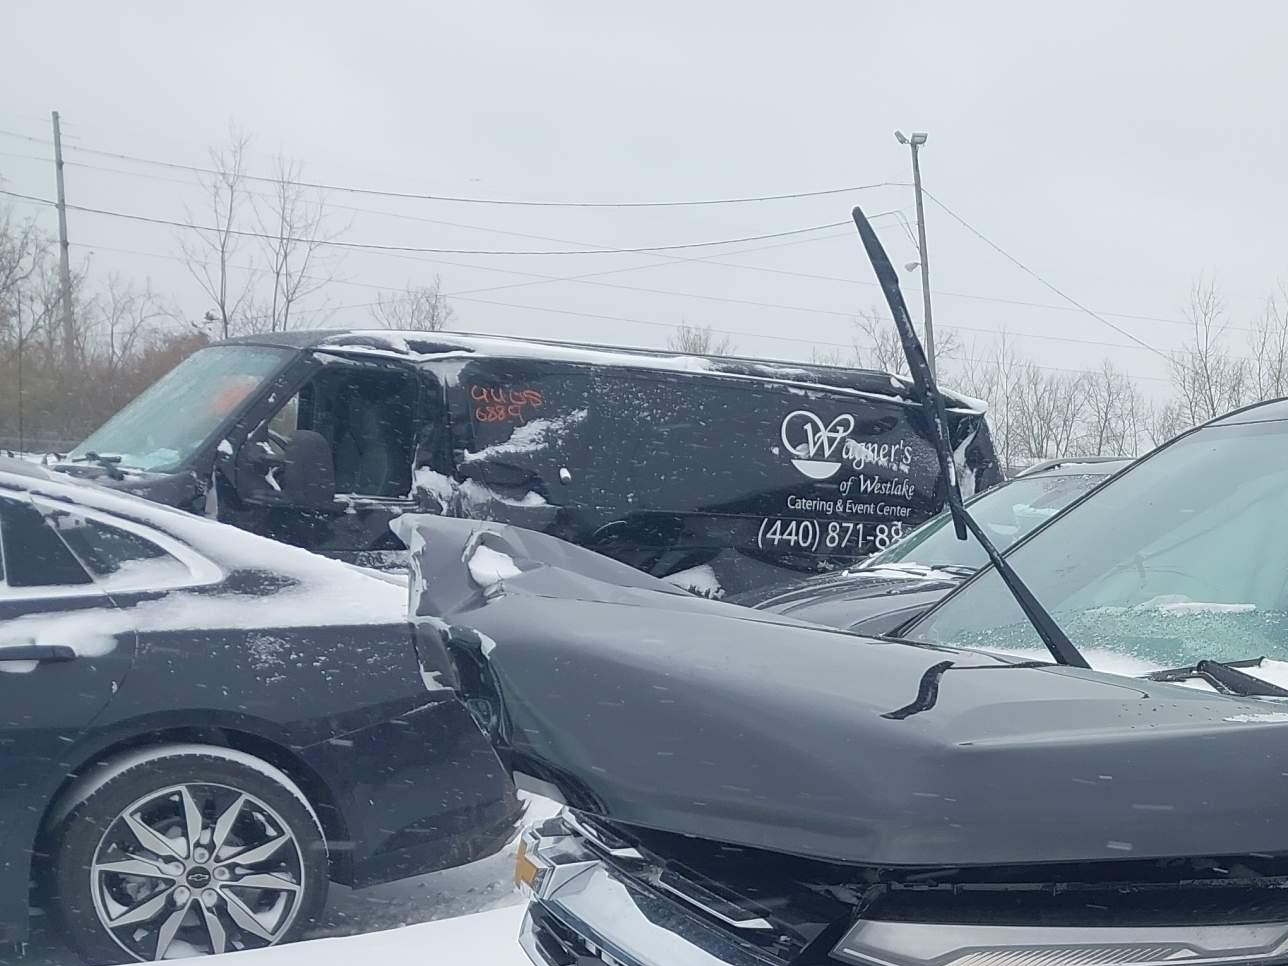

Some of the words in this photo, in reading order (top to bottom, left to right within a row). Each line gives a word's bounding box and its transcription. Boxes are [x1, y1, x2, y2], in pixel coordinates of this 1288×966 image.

[781, 410, 912, 470] Wagner's
[840, 476, 856, 496] of
[859, 474, 915, 500] Westlake
[787, 496, 833, 514] Catering
[835, 501, 844, 512] &
[845, 501, 875, 514] Event
[876, 503, 911, 517] Center
[758, 517, 820, 551] (440)
